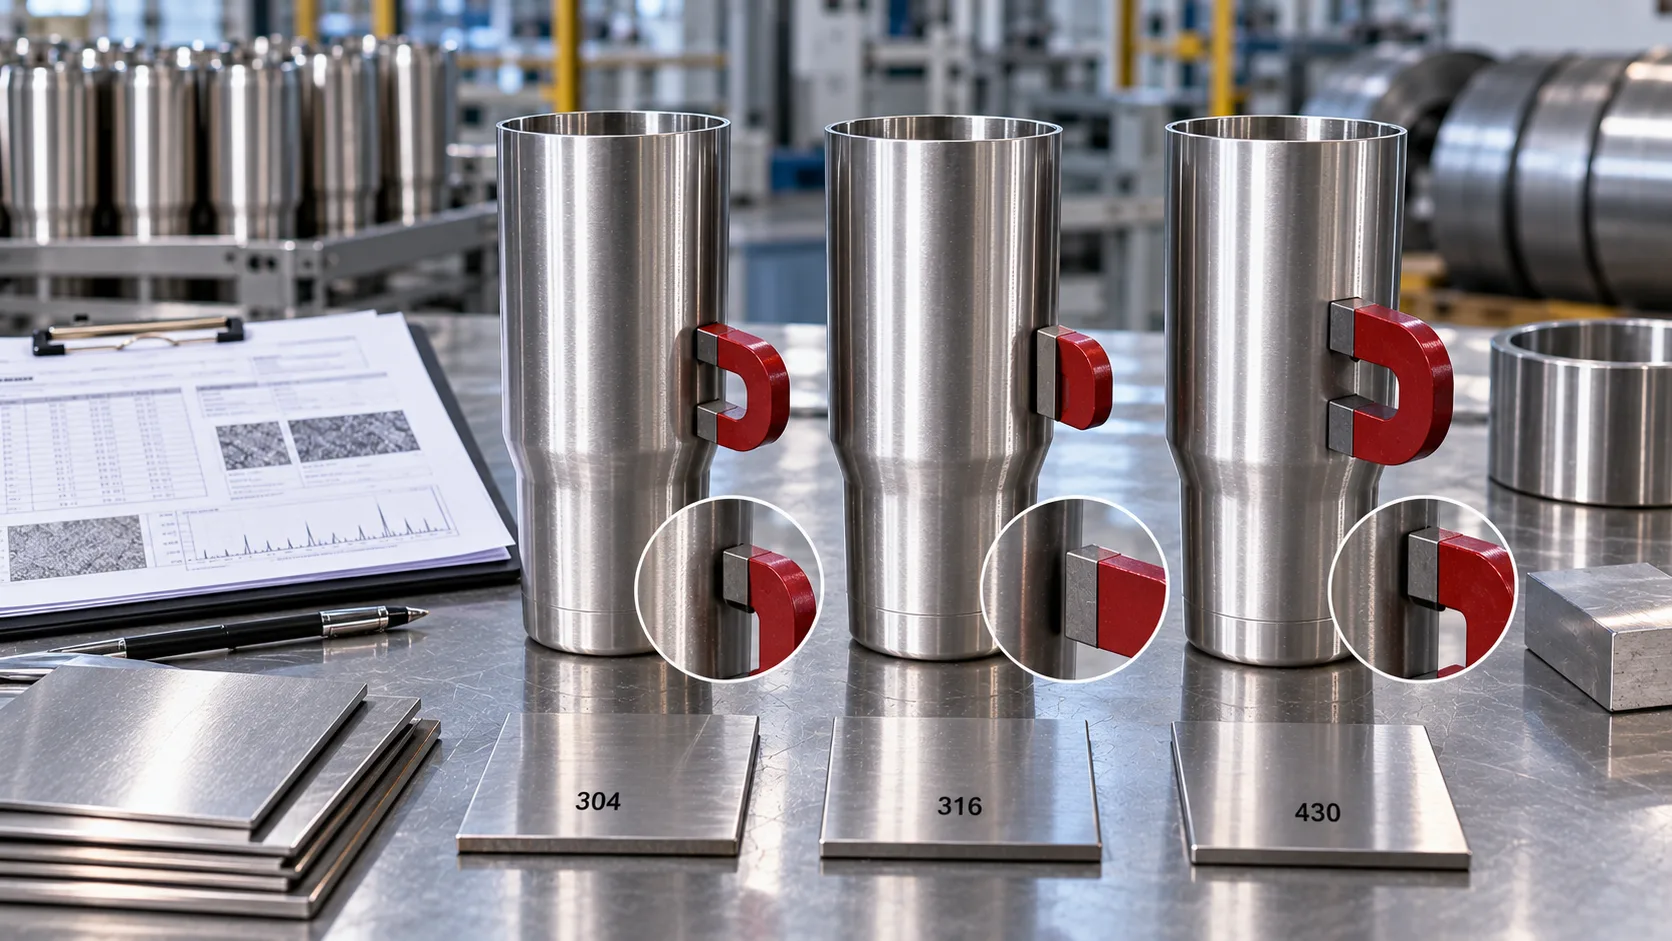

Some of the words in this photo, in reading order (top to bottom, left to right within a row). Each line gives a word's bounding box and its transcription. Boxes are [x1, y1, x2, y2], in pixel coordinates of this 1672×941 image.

[575, 791, 621, 811] 304
[937, 796, 983, 816] 316
[1294, 802, 1341, 822] 430
